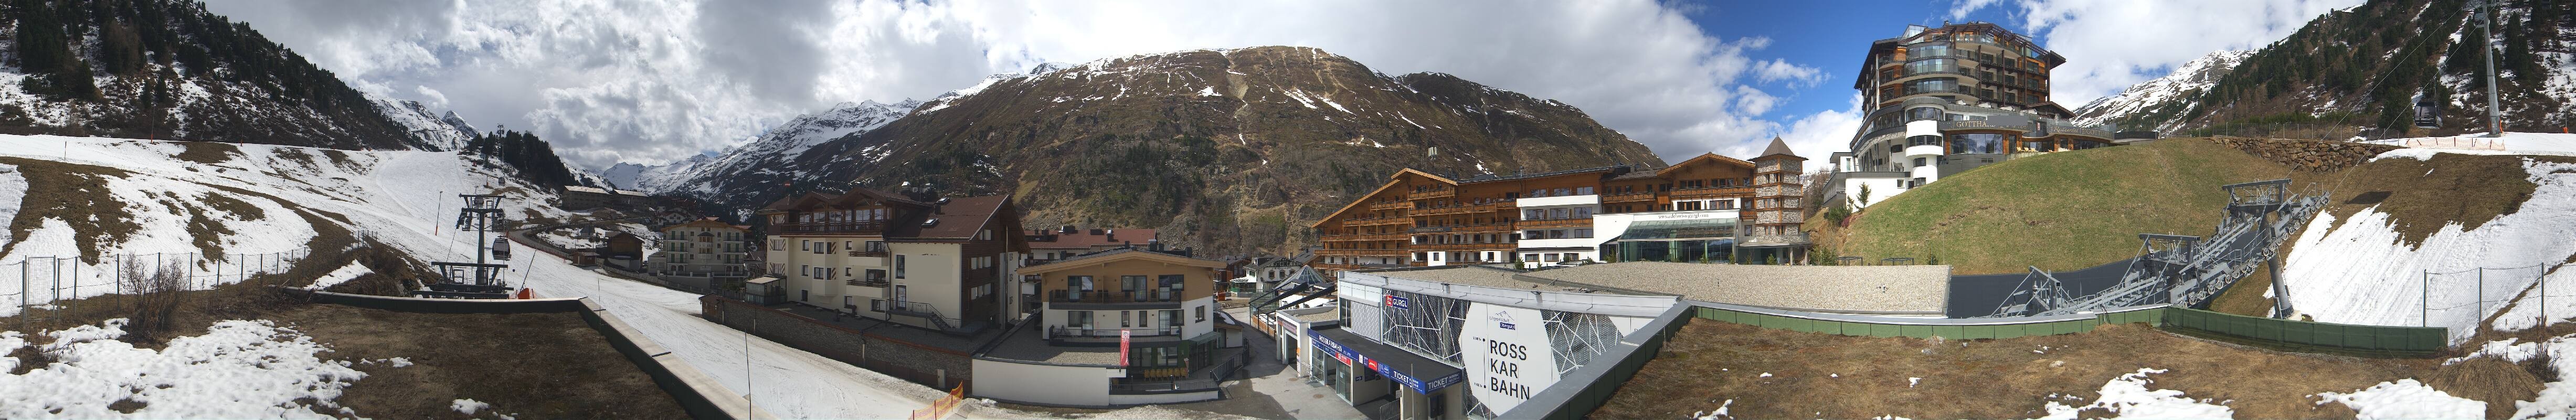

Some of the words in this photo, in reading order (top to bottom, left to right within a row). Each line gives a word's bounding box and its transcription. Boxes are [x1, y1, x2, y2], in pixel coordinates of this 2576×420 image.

[1393, 299, 1407, 307] GURGL
[1319, 335, 1342, 352] ROSSKARBAHN
[1490, 339, 1527, 361] ROSS
[1394, 371, 1409, 383] TICKET
[1490, 358, 1518, 379] KAR
[1428, 377, 1448, 390] TICKET
[1491, 376, 1530, 400] BAHN
